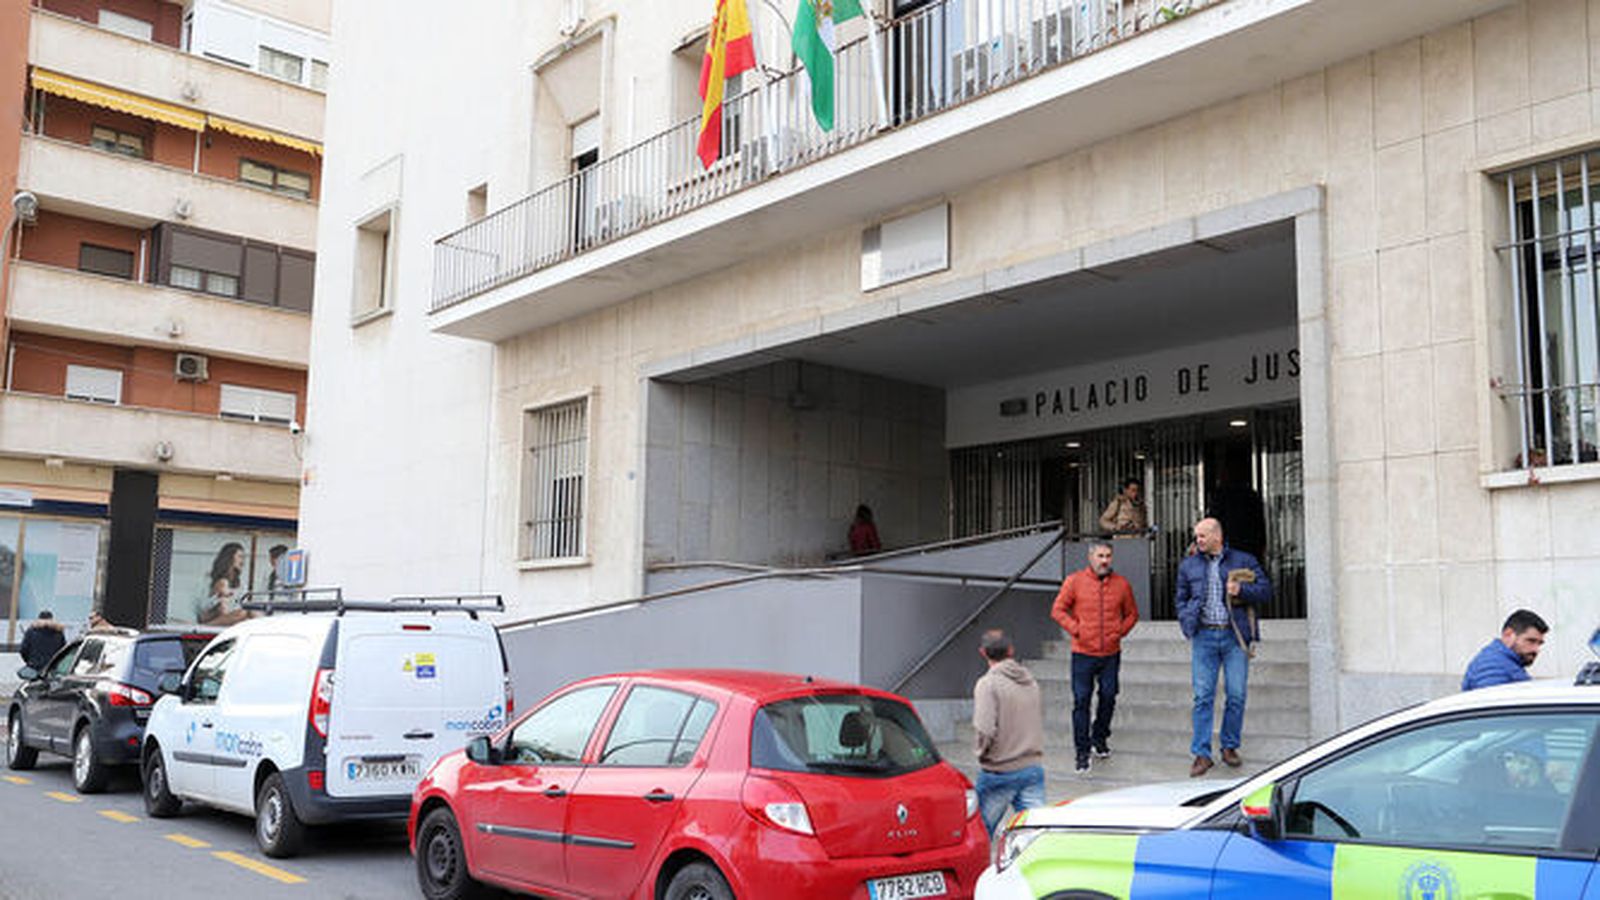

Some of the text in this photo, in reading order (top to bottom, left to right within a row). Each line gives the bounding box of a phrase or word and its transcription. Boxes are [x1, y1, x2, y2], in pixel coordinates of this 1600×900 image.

[1035, 375, 1148, 417] PALACIO
[1178, 364, 1210, 395] DE
[391, 763, 416, 776] KN
[877, 878, 914, 900] 7782
